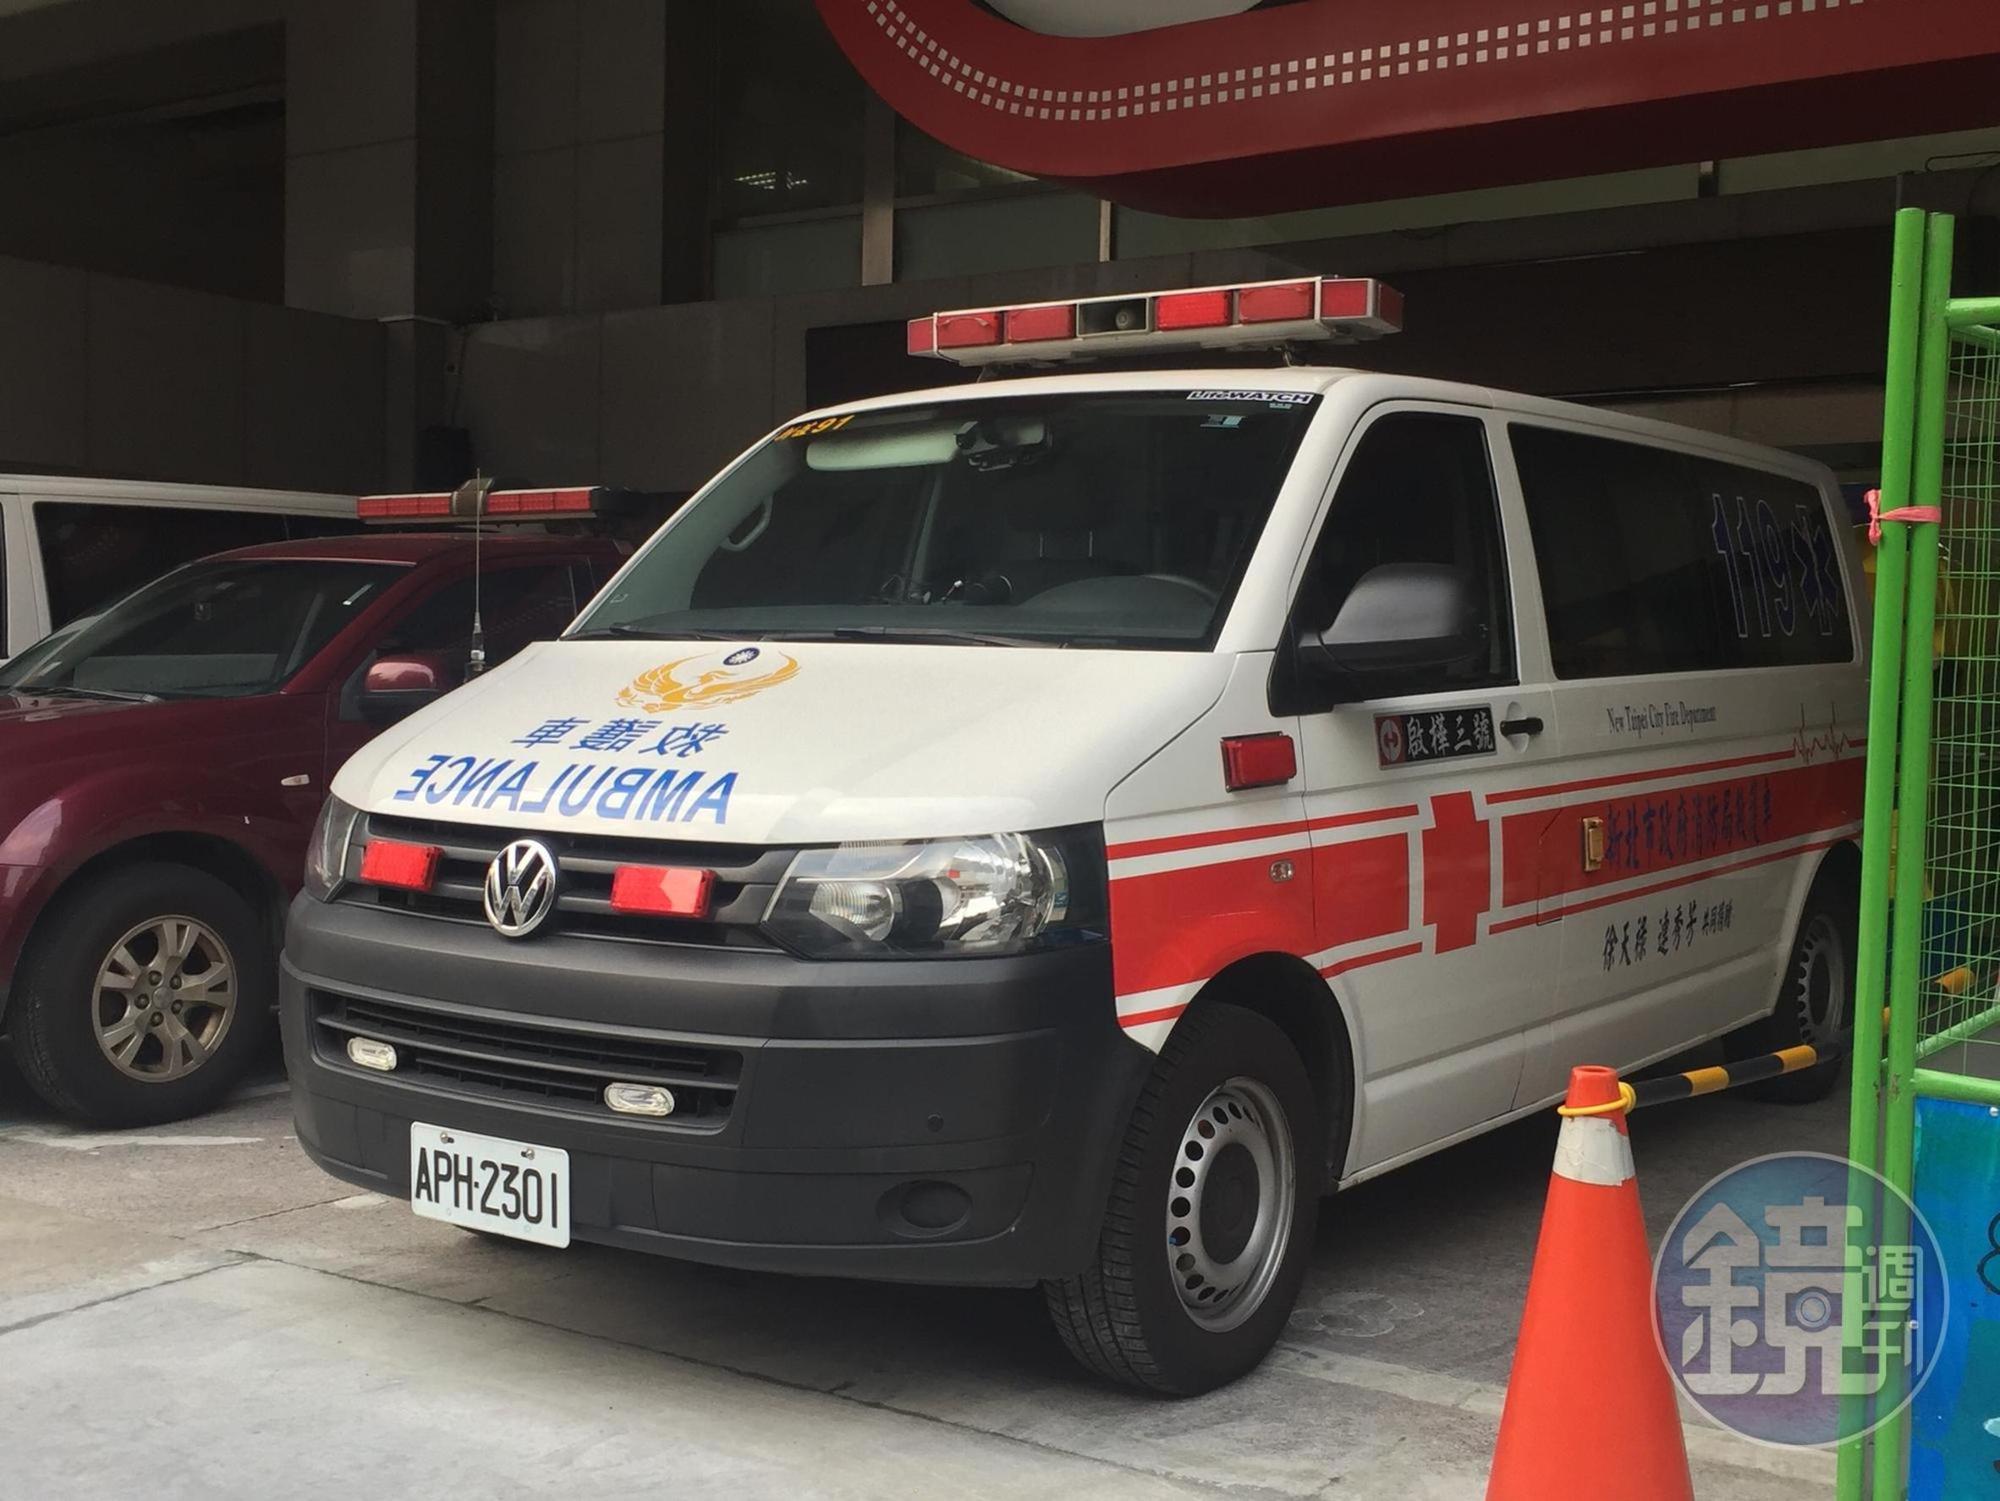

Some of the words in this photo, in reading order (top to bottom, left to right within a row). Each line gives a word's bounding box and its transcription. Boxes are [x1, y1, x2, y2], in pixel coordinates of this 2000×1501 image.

[1712, 493, 1795, 636] 119
[1606, 708, 1624, 734] New
[1625, 705, 1648, 739] Taipei
[1648, 703, 1663, 736] City
[1664, 702, 1679, 728] Fire
[1679, 701, 1717, 733] Department
[415, 1147, 557, 1229] APH-2301
